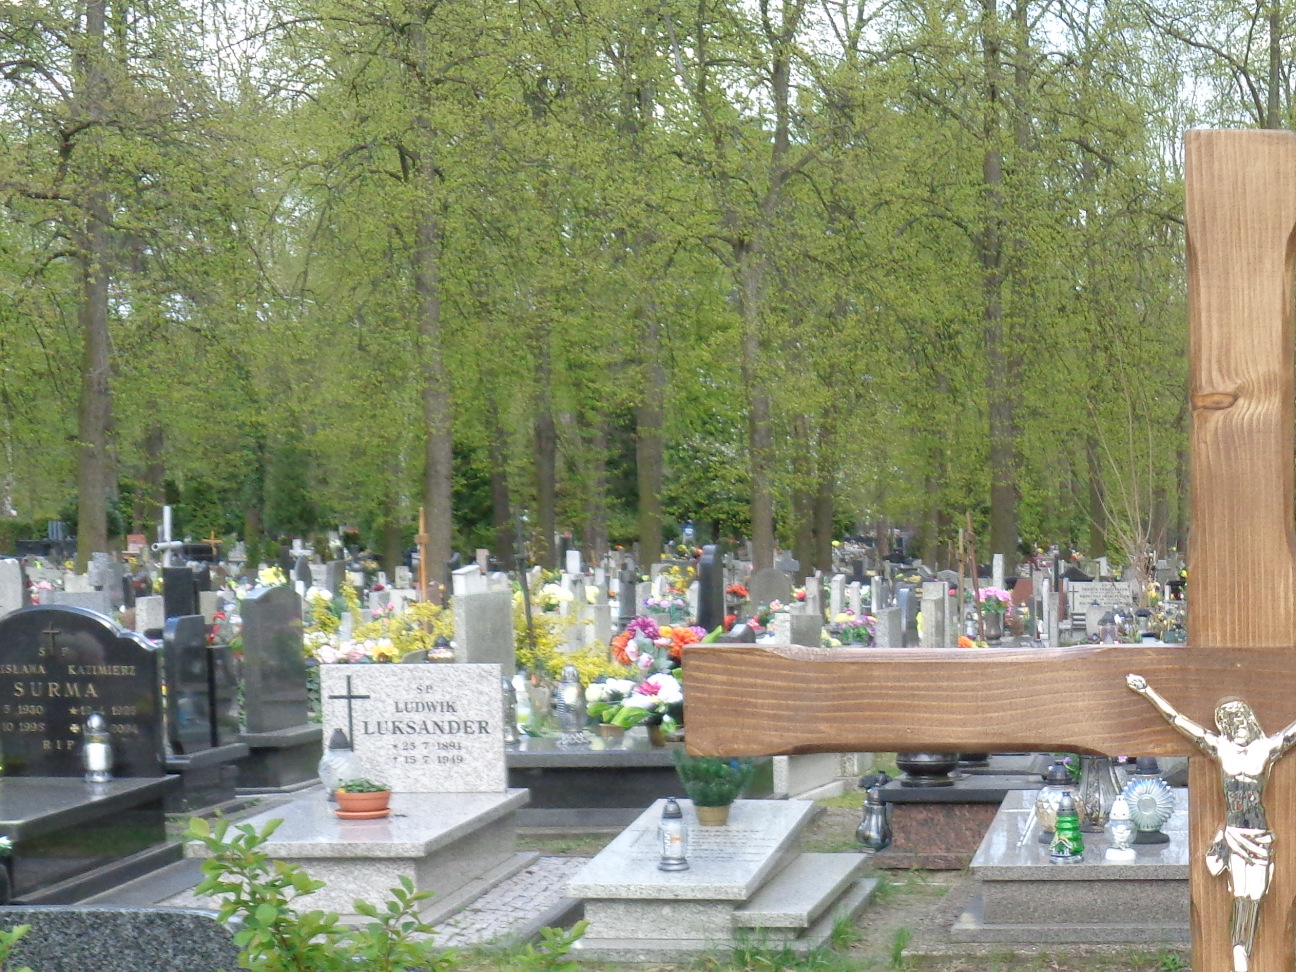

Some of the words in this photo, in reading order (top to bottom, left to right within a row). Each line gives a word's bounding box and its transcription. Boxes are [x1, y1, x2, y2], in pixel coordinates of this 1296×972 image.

[13, 681, 98, 698] SURMA
[394, 701, 458, 713] LUDWIK
[362, 719, 491, 735] LUKSANDER
